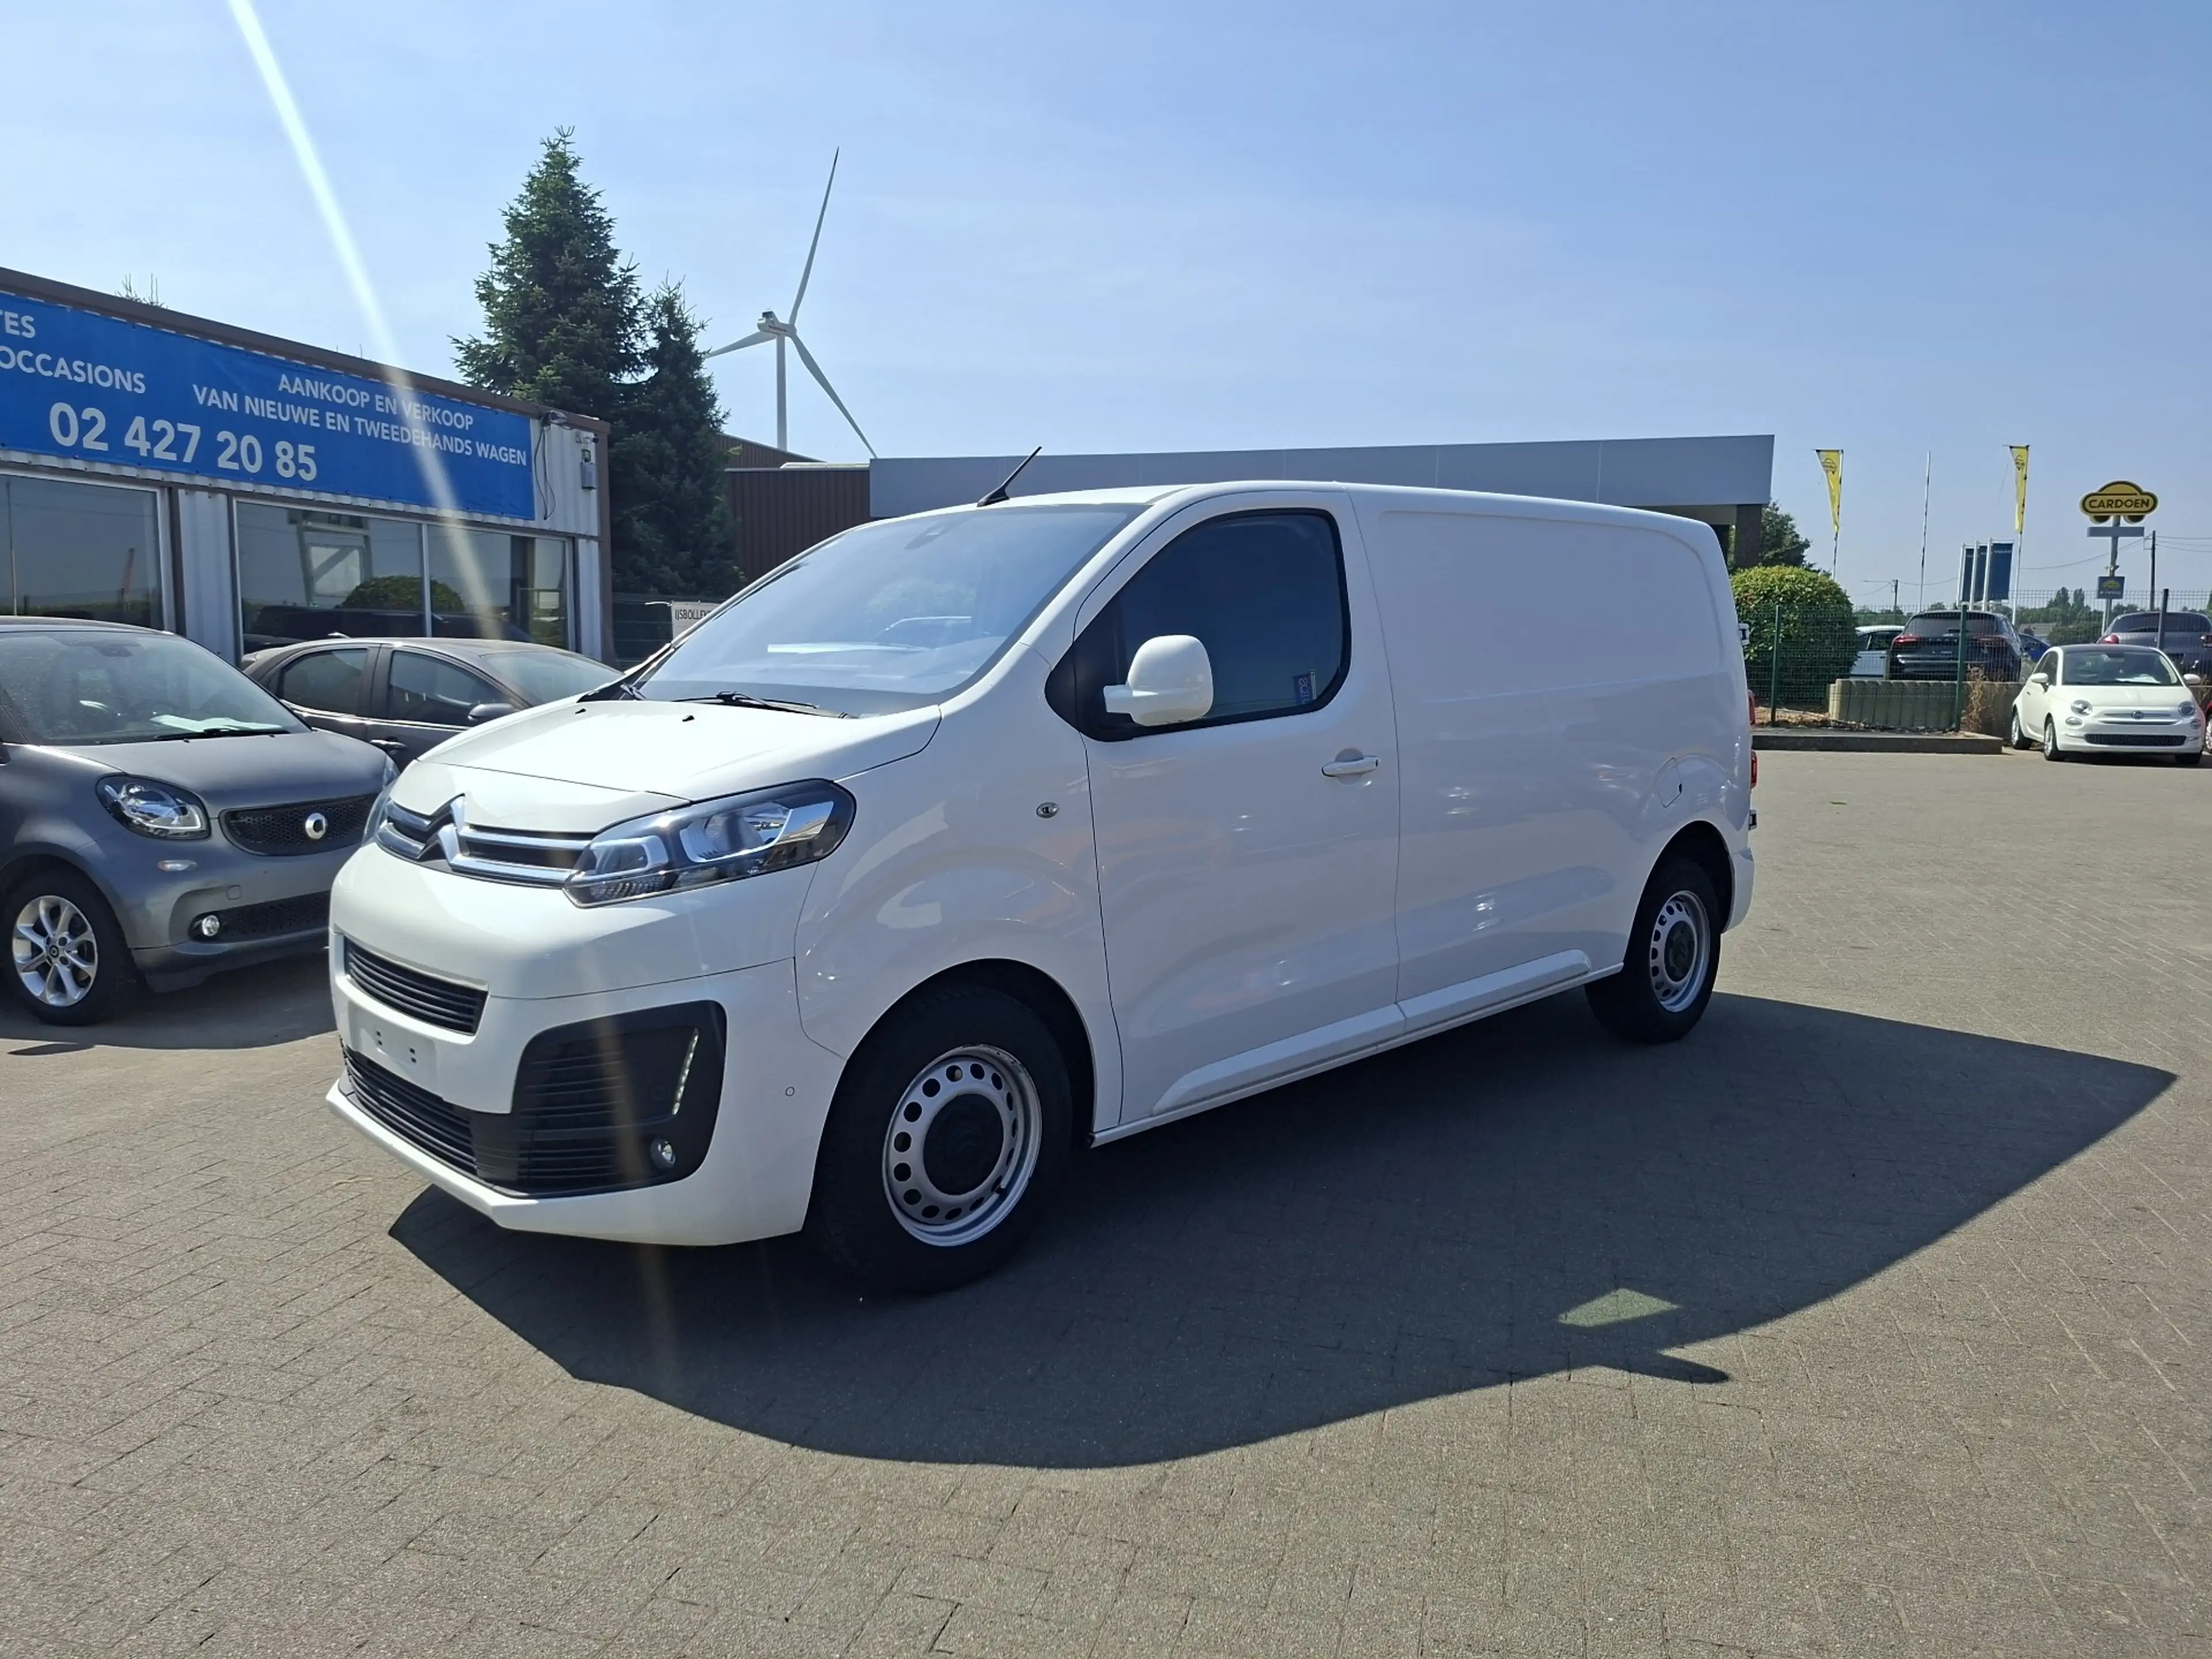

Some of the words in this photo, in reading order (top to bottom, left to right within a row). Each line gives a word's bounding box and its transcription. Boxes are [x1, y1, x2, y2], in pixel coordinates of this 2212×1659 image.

[0, 310, 36, 339] ES
[0, 346, 146, 394] OCCASIONS
[192, 384, 238, 412] VAN
[245, 395, 320, 427] NIEUWE
[326, 411, 350, 433] EN
[354, 417, 473, 456] TWEEDEHANDS
[476, 441, 527, 466] WAGEN
[279, 374, 370, 408] AANKOOP
[374, 394, 397, 415] EN
[402, 400, 474, 430] VERKOOP
[50, 402, 109, 451] 02
[124, 416, 201, 463] 427
[217, 431, 263, 474] 20
[275, 441, 317, 482] 85
[2089, 498, 2150, 508] CARDOEN
